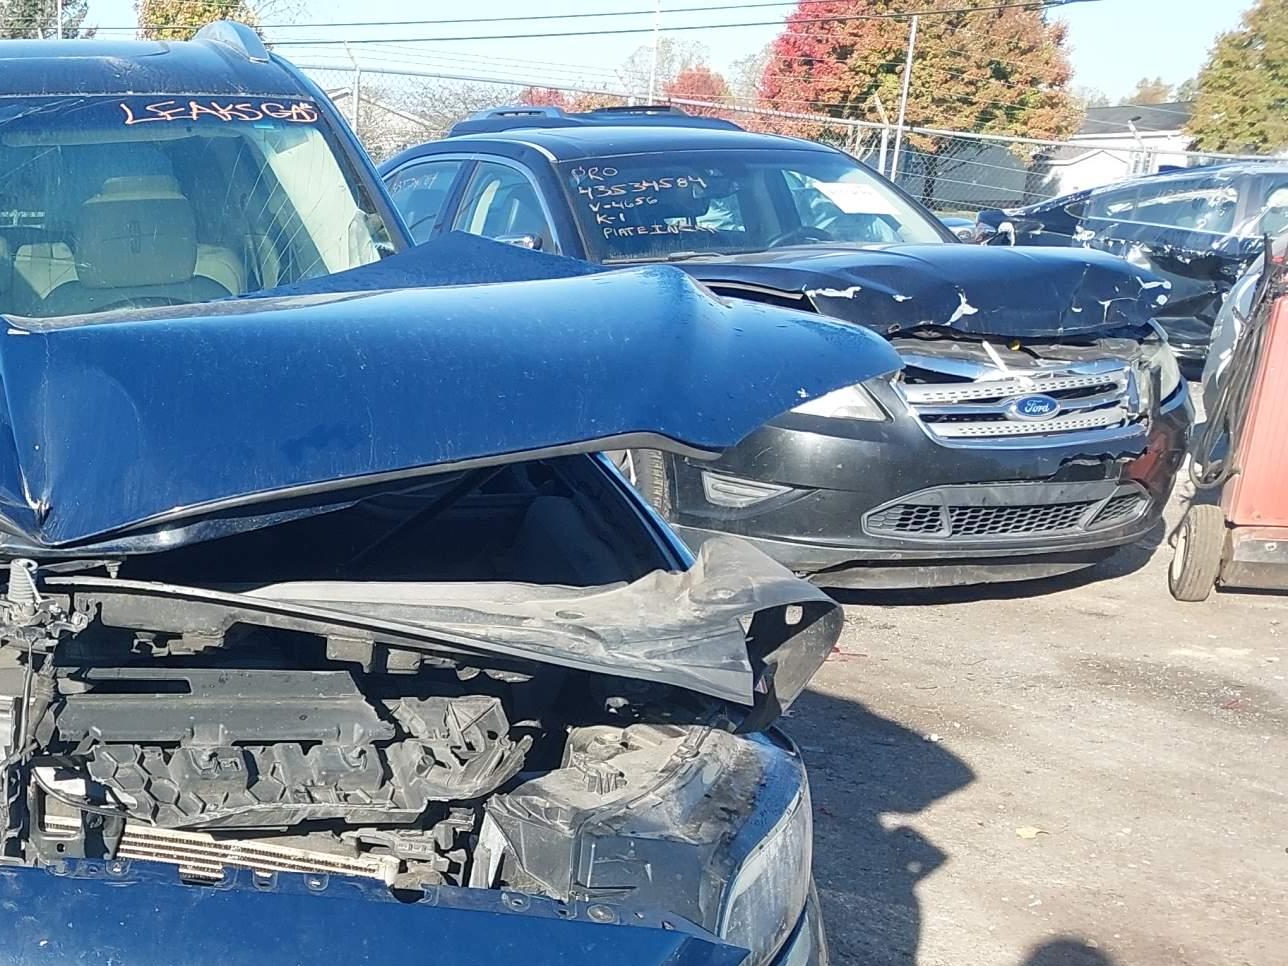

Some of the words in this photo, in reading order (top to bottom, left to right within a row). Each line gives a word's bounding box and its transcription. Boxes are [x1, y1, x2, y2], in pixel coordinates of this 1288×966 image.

[579, 176, 707, 199] 43534584
[589, 196, 658, 212] V-4656
[596, 213, 626, 224] K-1
[1024, 400, 1050, 413] Ford
